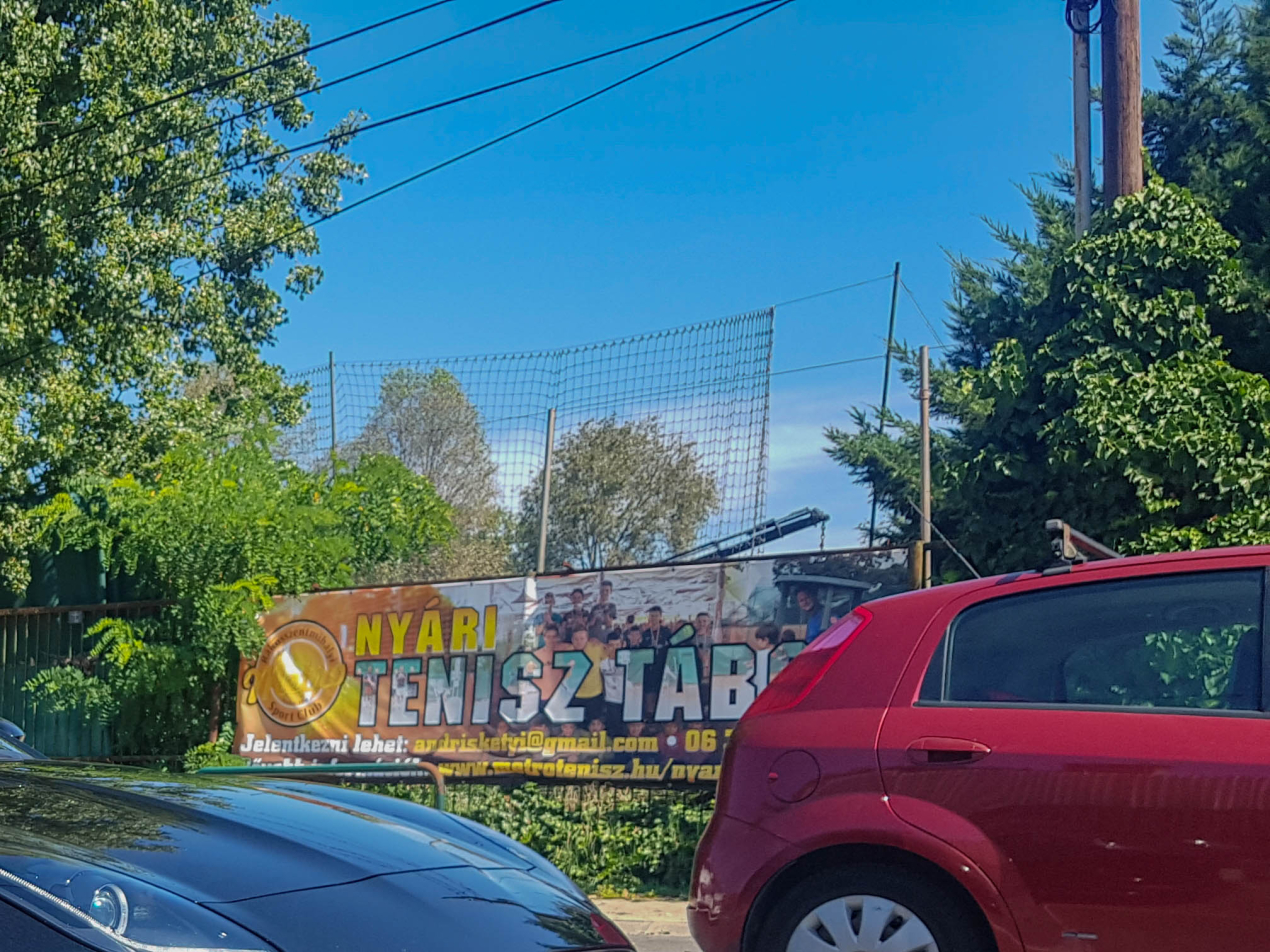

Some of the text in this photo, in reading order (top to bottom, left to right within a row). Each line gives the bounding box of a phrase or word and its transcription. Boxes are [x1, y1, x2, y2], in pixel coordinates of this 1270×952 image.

[354, 597, 499, 656] NYÁRI
[354, 649, 593, 727] TENISZ
[269, 701, 323, 722] Sport Club
[240, 733, 349, 754] Jelentkezni
[352, 733, 409, 754] lehet:
[685, 728, 717, 752] 06
